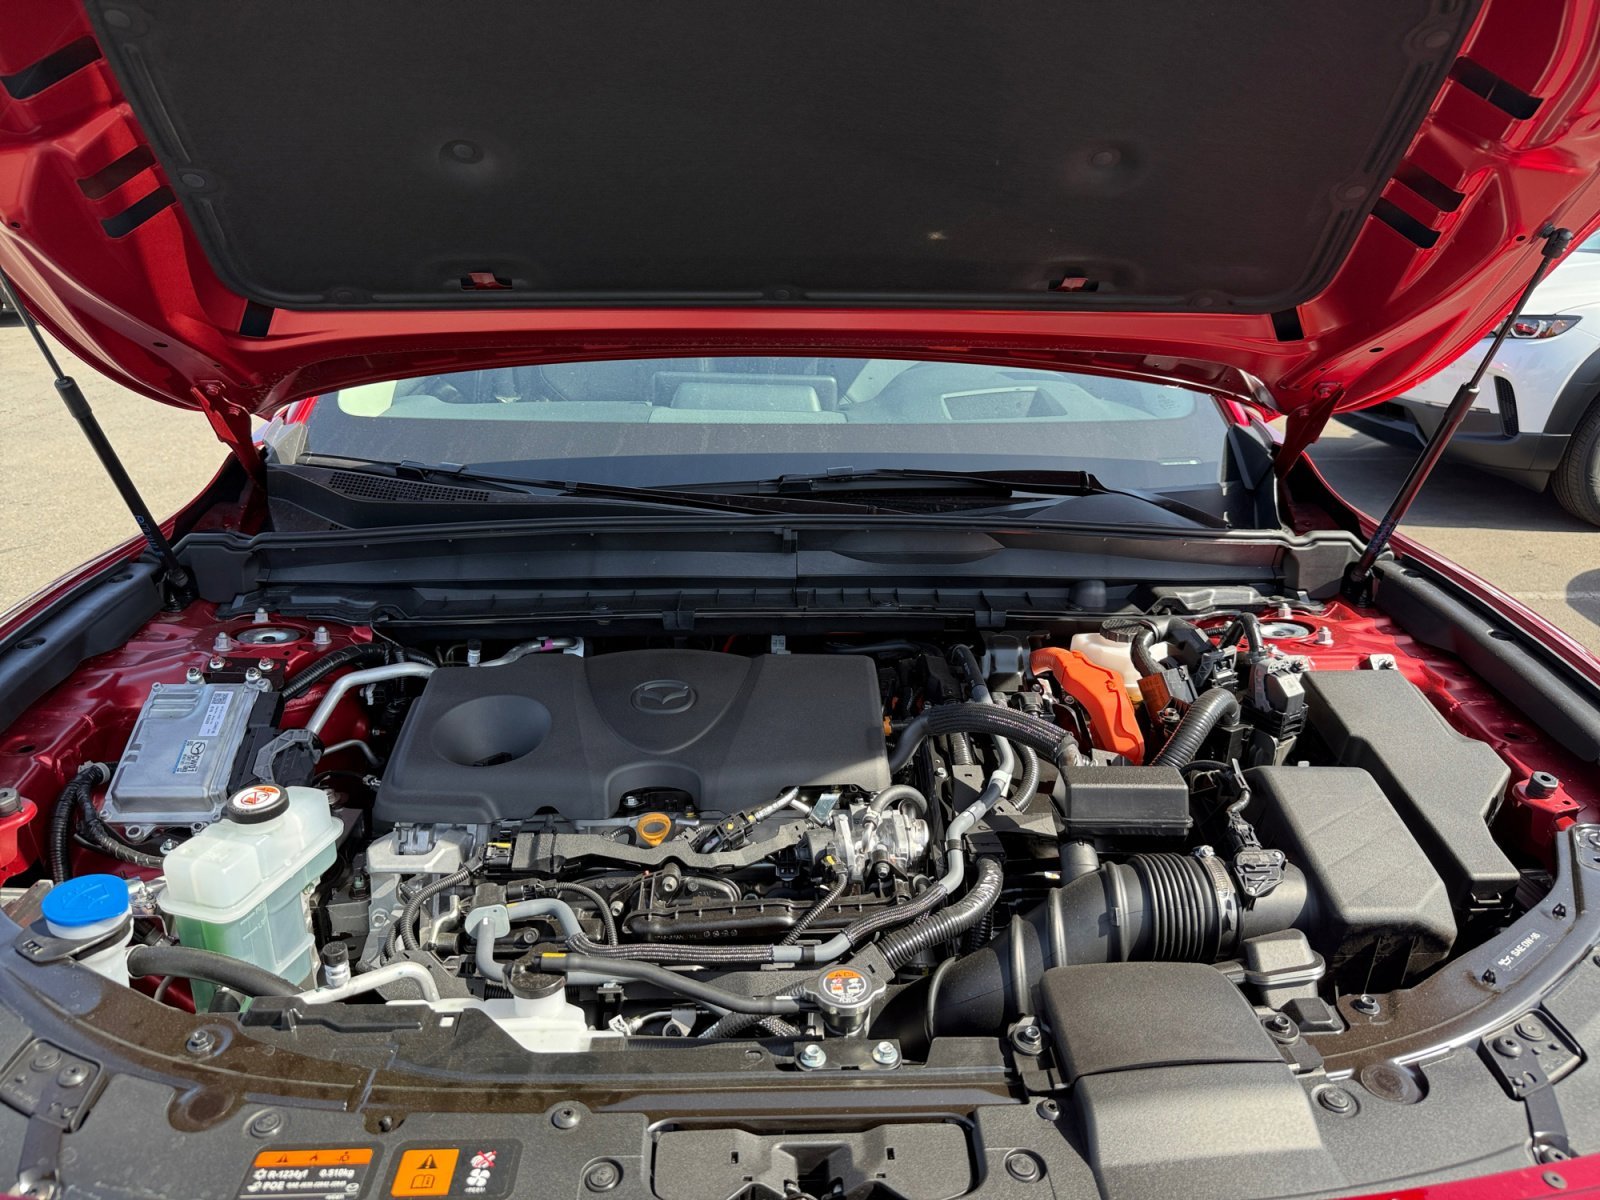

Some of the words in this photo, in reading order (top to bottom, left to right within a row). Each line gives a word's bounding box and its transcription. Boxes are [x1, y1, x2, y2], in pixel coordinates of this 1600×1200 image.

[1510, 945, 1526, 957] SAE
[267, 1169, 309, 1181] R-1234yf
[319, 1168, 355, 1179] 0.510kg
[262, 1181, 286, 1191] POE
